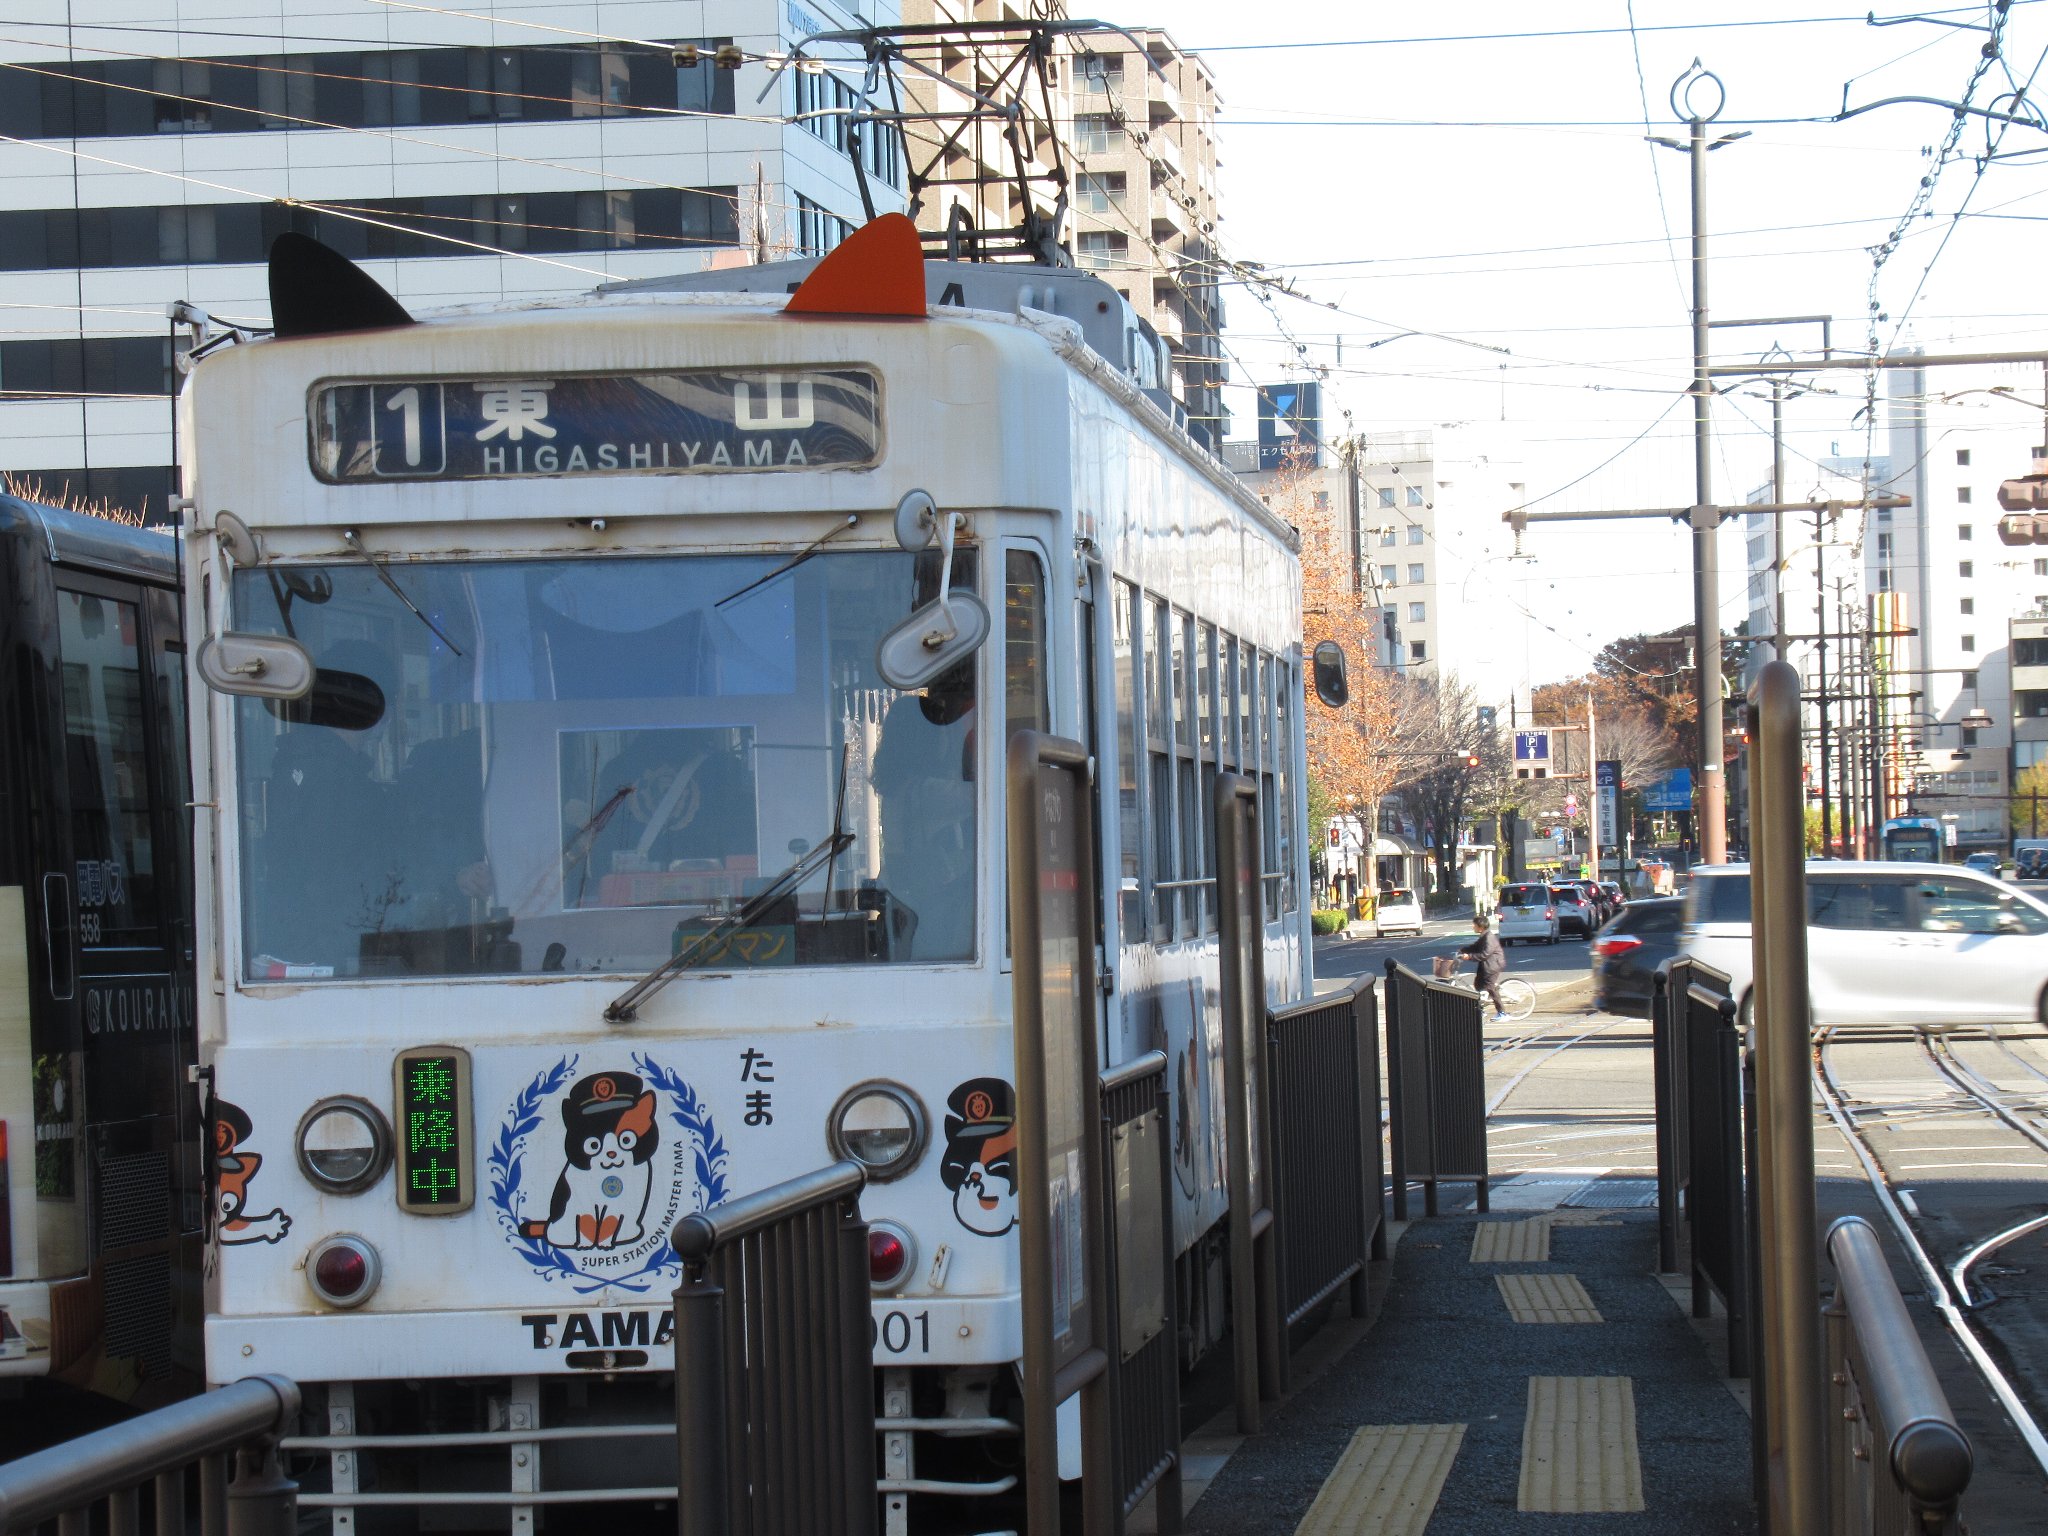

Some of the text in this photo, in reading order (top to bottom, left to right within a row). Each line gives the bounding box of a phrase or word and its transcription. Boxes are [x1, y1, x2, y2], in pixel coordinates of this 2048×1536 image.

[386, 387, 421, 467] 1
[474, 380, 556, 442] 東
[484, 438, 807, 473] HIGASHIYAMA
[80, 914, 101, 944] 558
[740, 1047, 775, 1127] たま
[410, 1060, 456, 1202] 乗降中
[582, 1140, 684, 1268] SUPER STATION MASTER TAMA
[871, 1310, 929, 1354] 01
